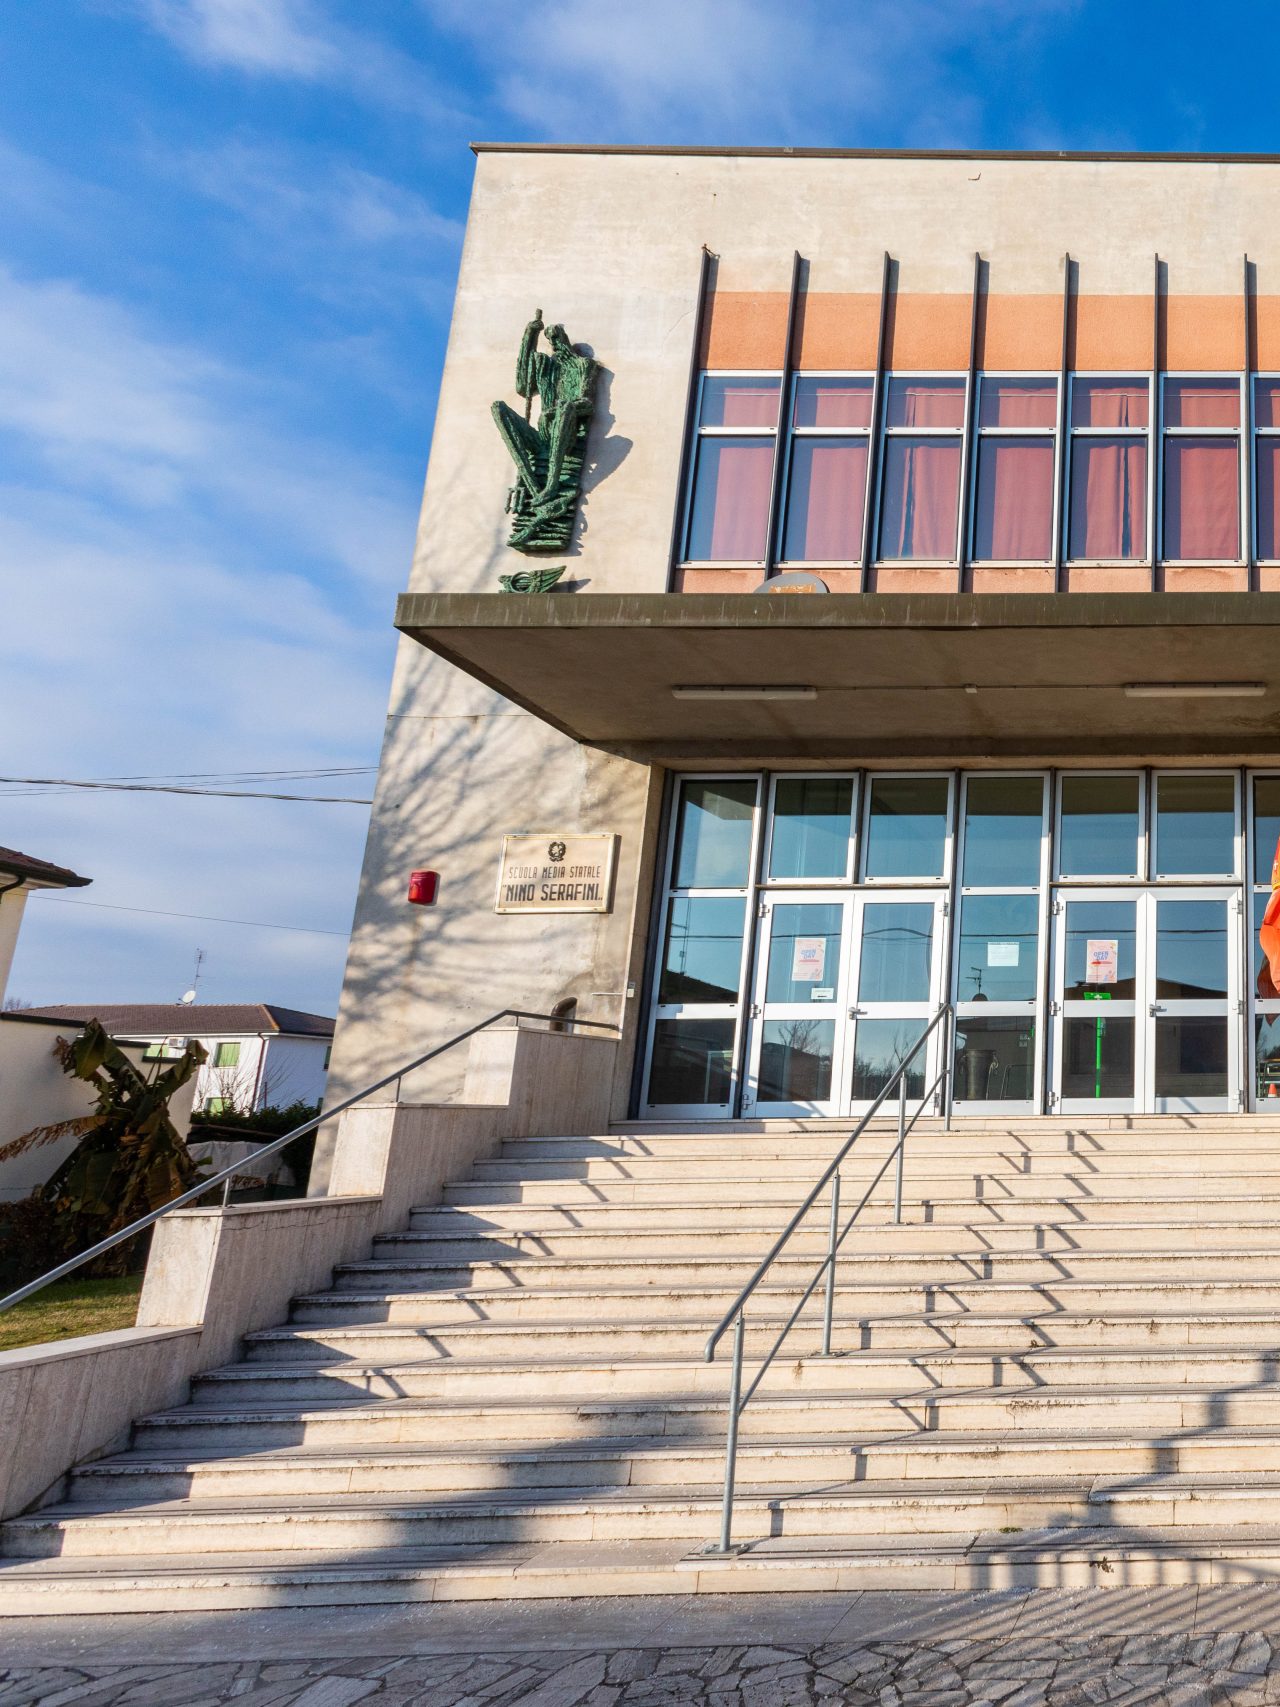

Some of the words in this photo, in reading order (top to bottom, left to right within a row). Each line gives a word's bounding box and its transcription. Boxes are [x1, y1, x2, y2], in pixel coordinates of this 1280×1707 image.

[509, 866, 538, 879] SCUOLA
[542, 866, 566, 879] MEDIA
[569, 865, 601, 879] STATALE
